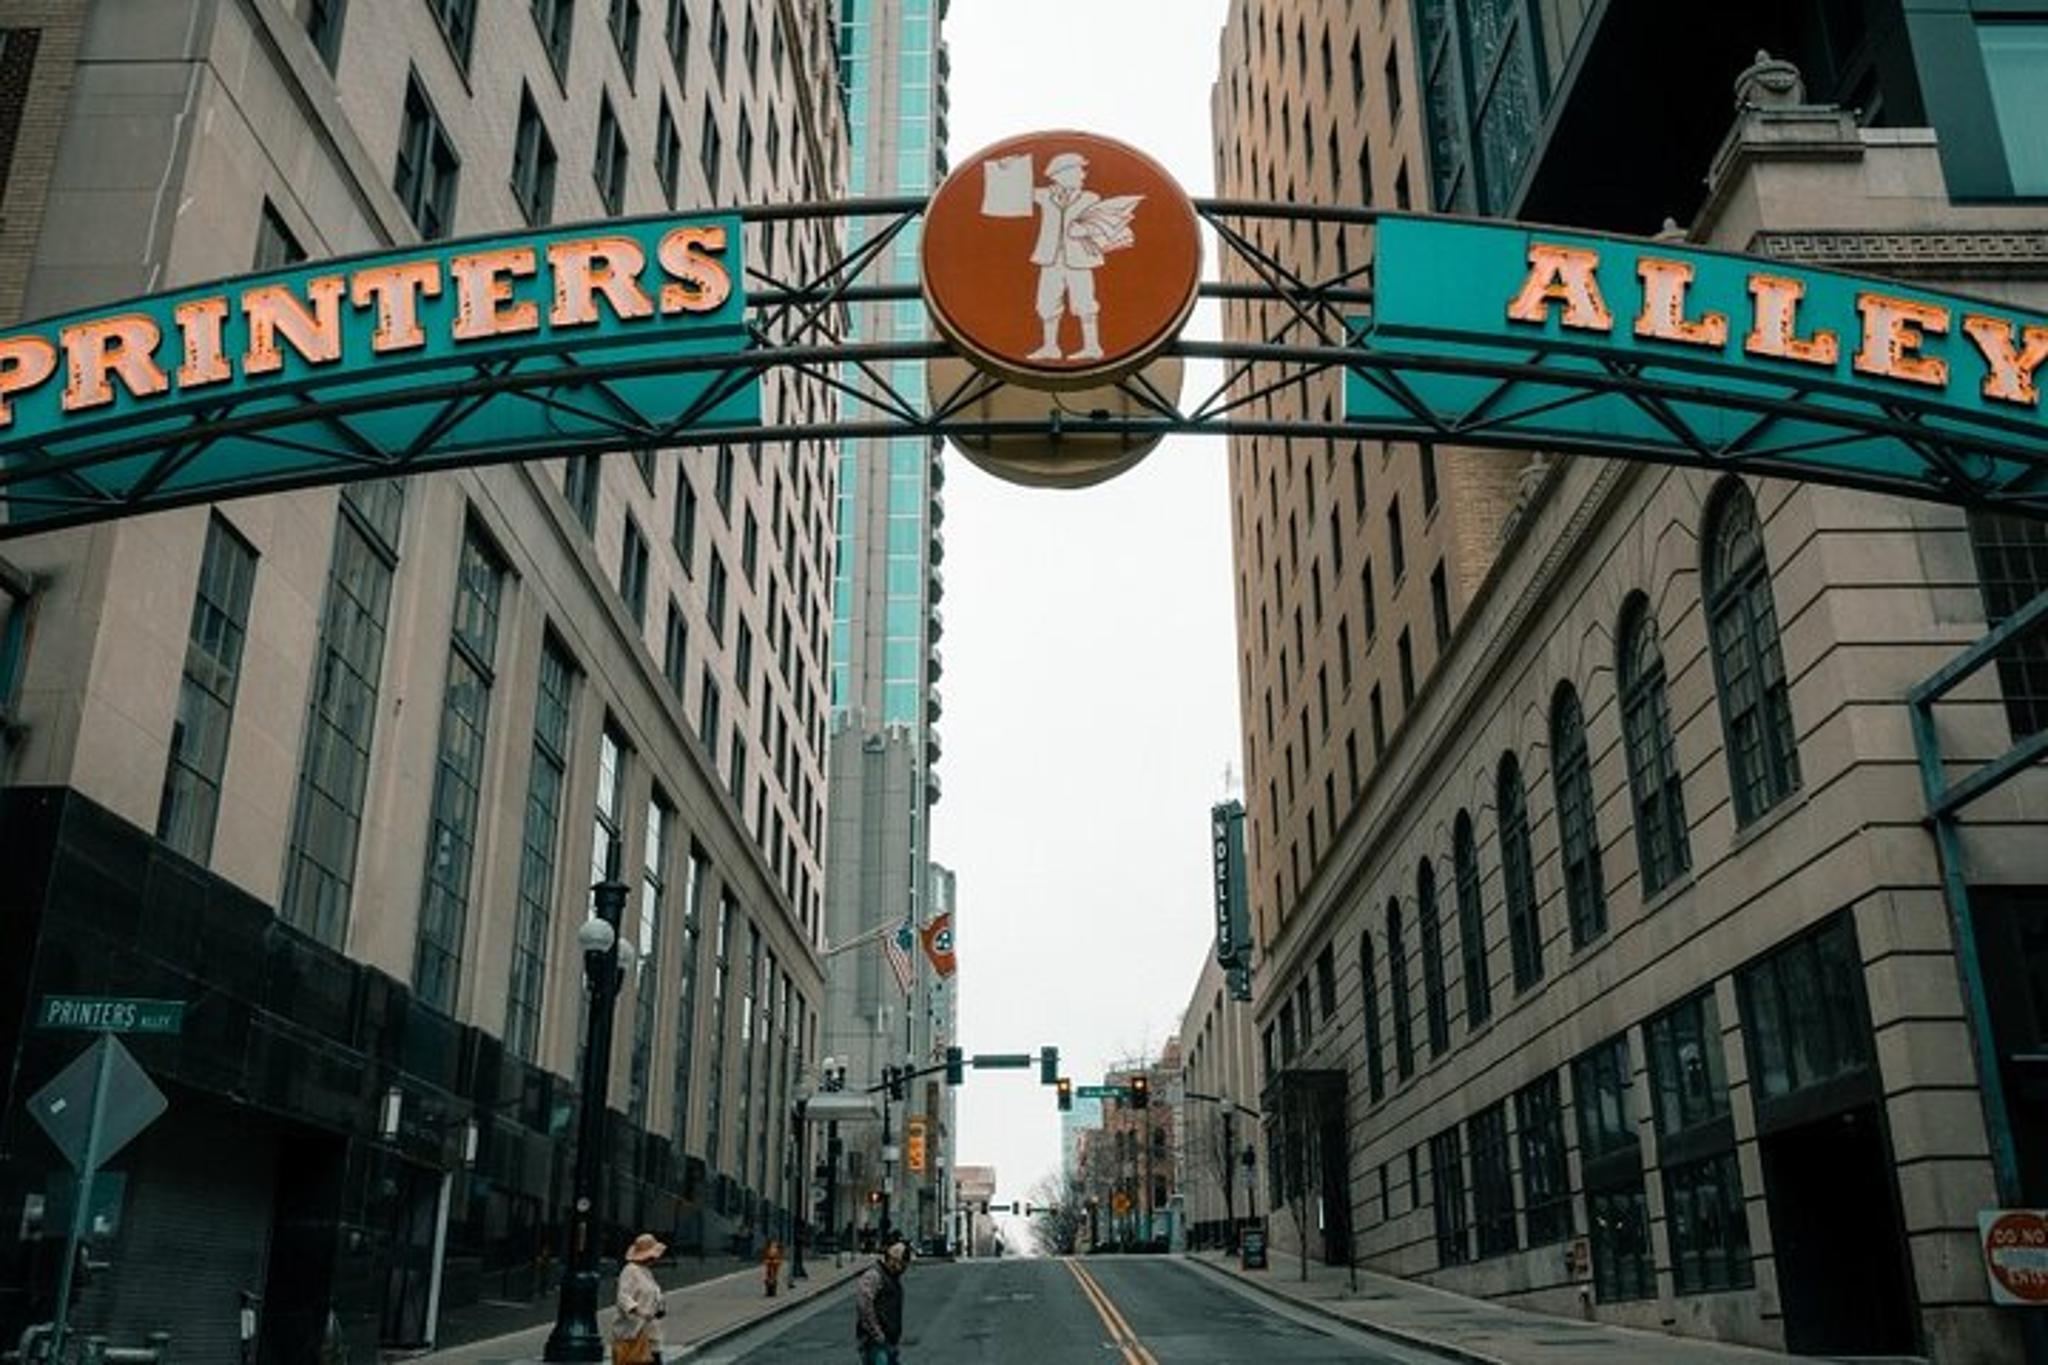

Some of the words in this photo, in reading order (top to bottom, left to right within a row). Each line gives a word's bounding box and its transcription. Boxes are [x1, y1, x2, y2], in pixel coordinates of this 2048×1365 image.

[0, 226, 732, 425] PRINTERS
[1507, 243, 2048, 406] ALLEY
[47, 1000, 137, 1028] PRINTERS
[1994, 1227, 2017, 1245] DO
